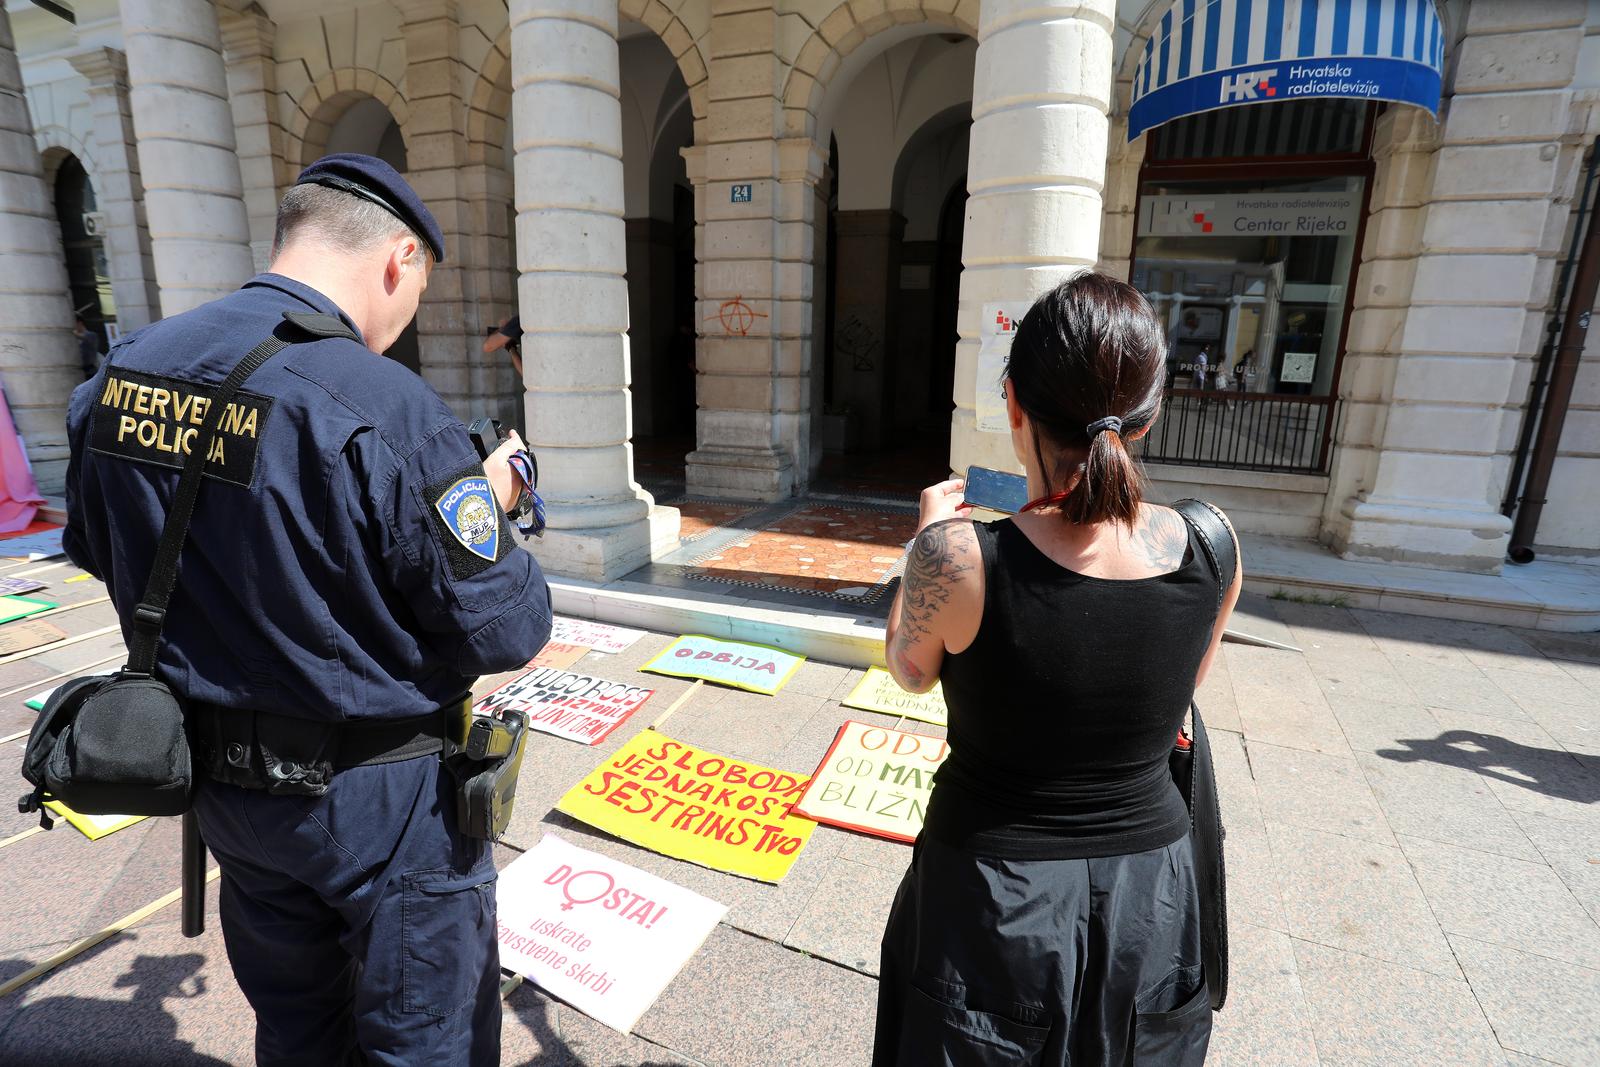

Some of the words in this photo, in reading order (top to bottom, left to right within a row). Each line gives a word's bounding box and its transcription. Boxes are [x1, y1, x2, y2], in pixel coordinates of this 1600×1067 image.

[1220, 69, 1278, 104] HRT
[1289, 63, 1352, 80] Hrvatska
[1287, 79, 1379, 97] radiotelevizija
[735, 186, 748, 197] 24
[1236, 199, 1279, 209] Hrvatska
[1281, 199, 1350, 209] radiotelevizija
[1233, 216, 1290, 232] Centar
[1296, 215, 1347, 234] Rijeka
[117, 415, 225, 466] POLICJA
[443, 482, 488, 512] POLICIJA
[470, 521, 490, 537] MUP
[674, 648, 776, 675] ODBIJA
[498, 684, 528, 697] SU
[514, 668, 592, 694] HUGO
[580, 680, 652, 706] BOSS
[647, 742, 812, 798] SLOBODA
[836, 756, 873, 777] OD
[613, 754, 798, 820] JEDNAKOST
[584, 771, 802, 856] SESTRINSTVO
[543, 864, 668, 930] DOSTA!
[529, 918, 592, 953] uskrate
[565, 962, 617, 996] skrbi
